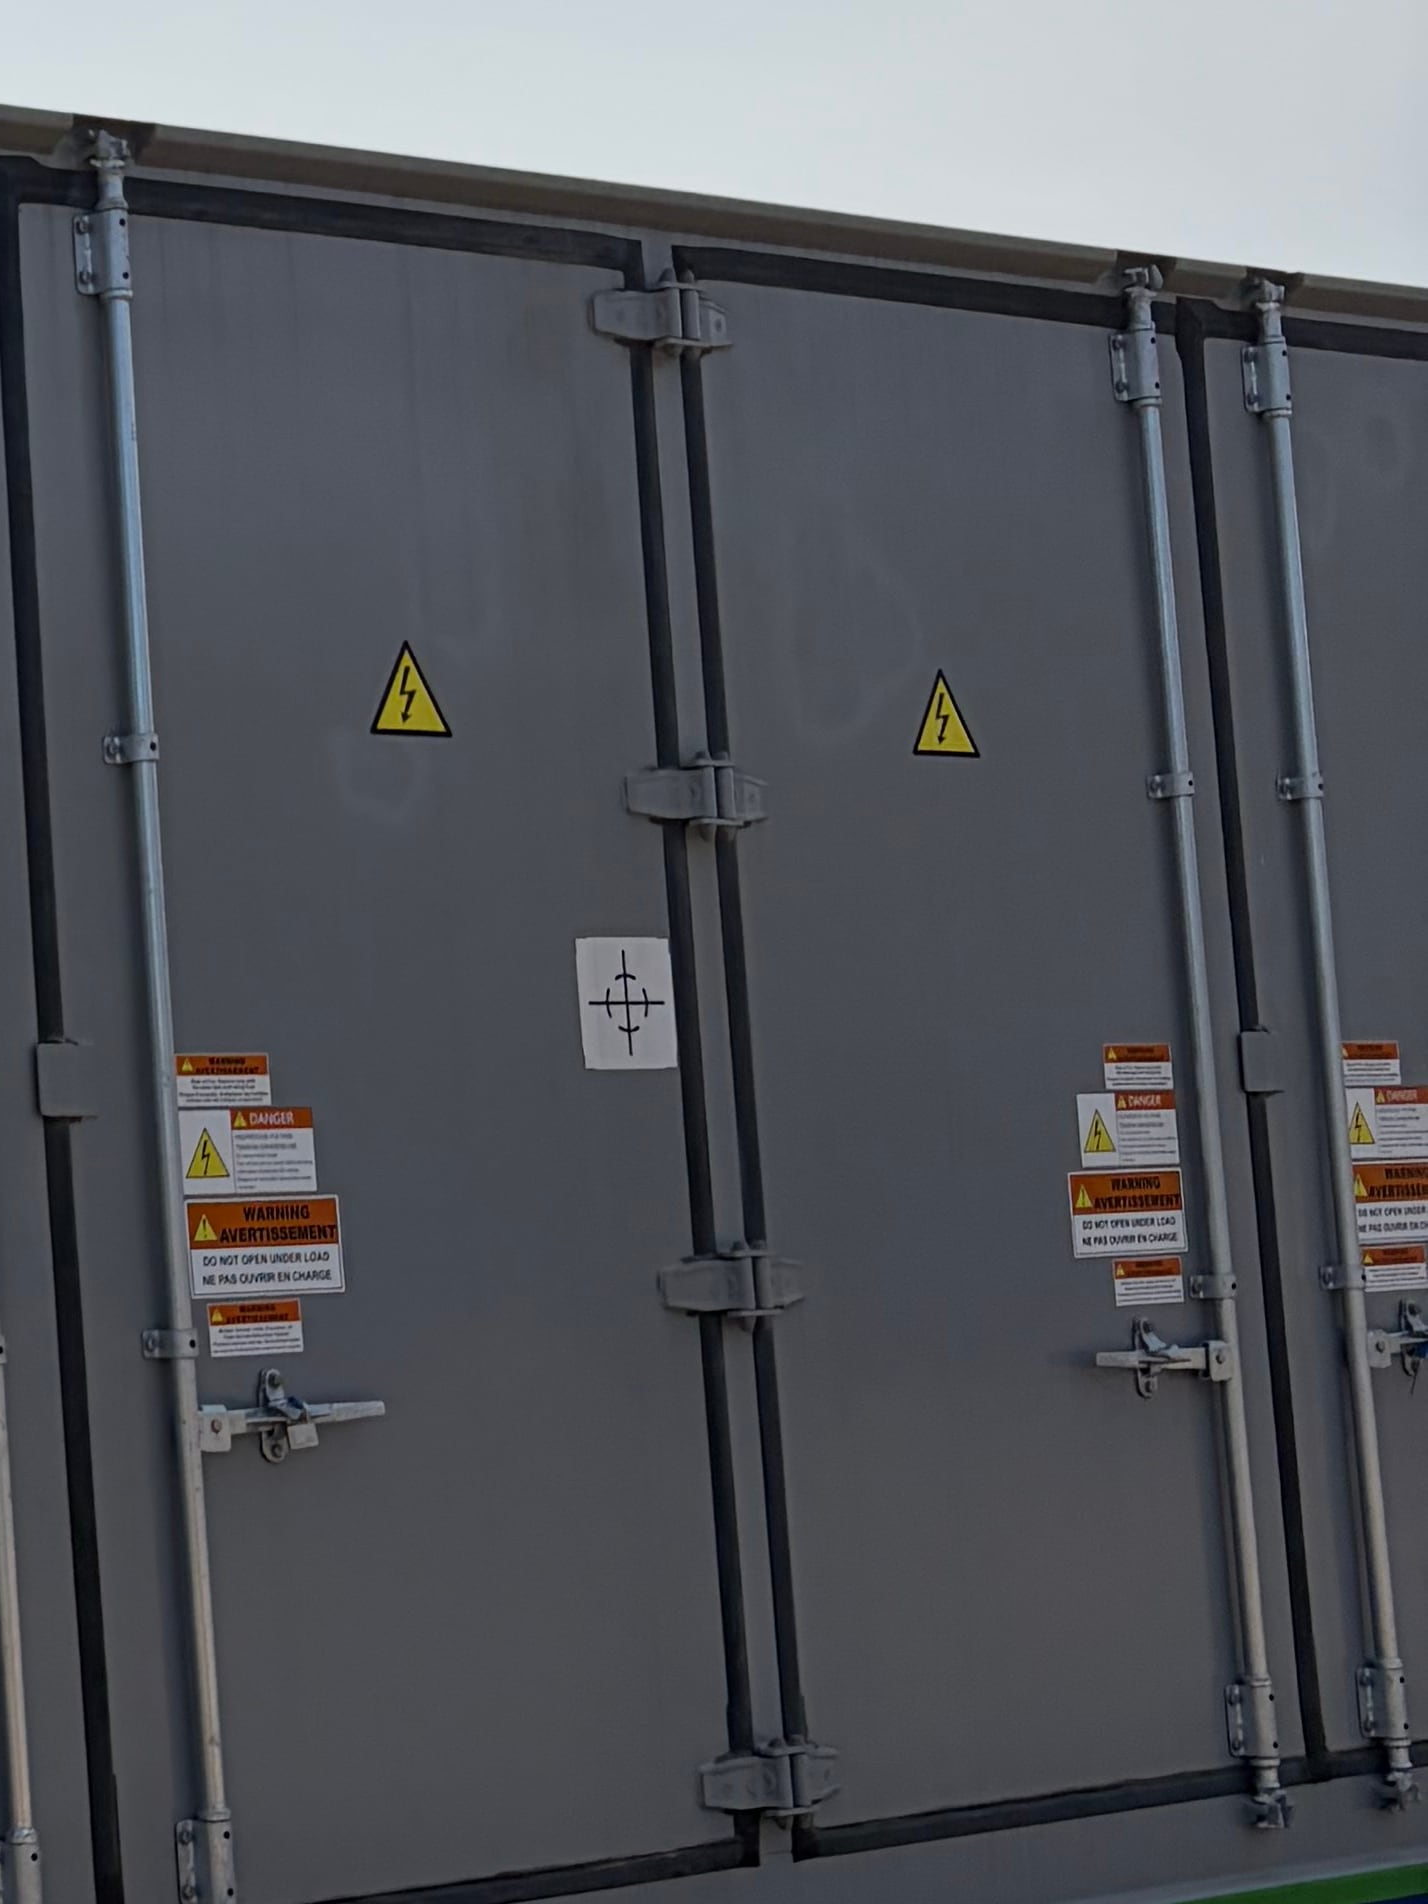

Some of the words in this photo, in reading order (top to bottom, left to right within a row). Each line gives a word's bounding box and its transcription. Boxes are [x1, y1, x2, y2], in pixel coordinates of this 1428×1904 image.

[249, 1112, 294, 1125] DANGER
[243, 1205, 310, 1222] WARNING
[220, 1224, 337, 1243] AVERTISSEMENT
[203, 1255, 217, 1267] DO
[220, 1254, 238, 1266] NOT
[241, 1253, 267, 1265] OPEN
[270, 1252, 302, 1264] UNDER
[304, 1251, 330, 1262] LOAD
[202, 1274, 216, 1286] NE
[218, 1273, 237, 1285] PAS
[278, 1271, 291, 1282] EN
[293, 1269, 332, 1281] CHARGE
